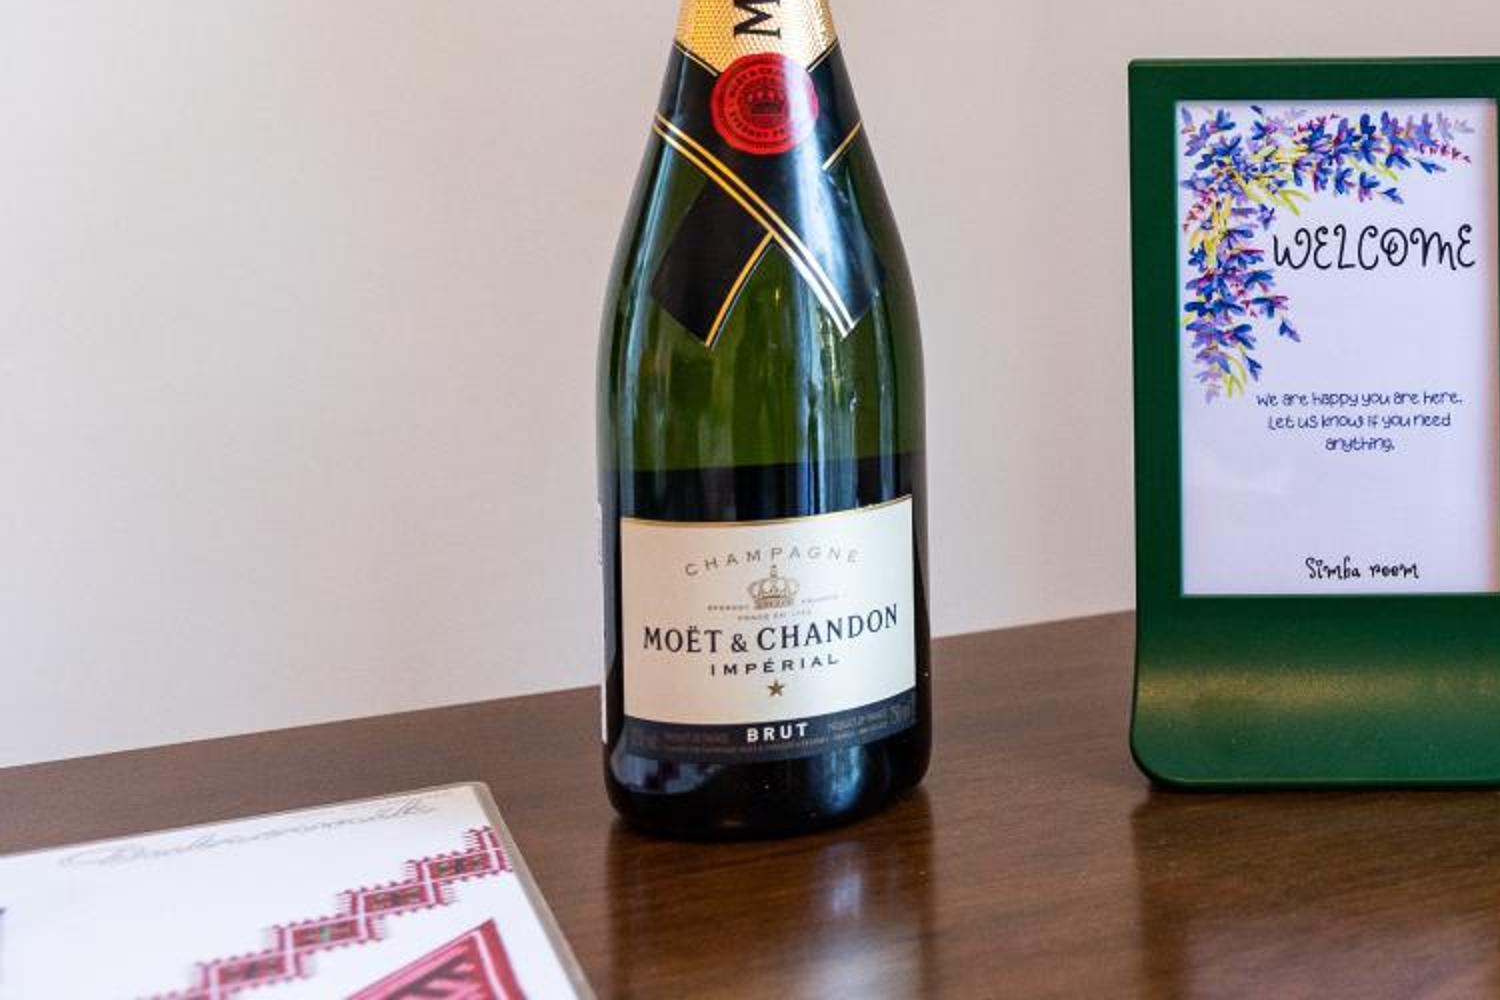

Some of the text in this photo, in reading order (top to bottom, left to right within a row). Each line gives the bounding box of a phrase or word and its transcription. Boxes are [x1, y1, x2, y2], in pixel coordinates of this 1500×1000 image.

[1272, 223, 1476, 271] WELCOME
[1282, 392, 1309, 406] are
[1312, 391, 1358, 407] happy
[1361, 391, 1390, 406] you
[1393, 391, 1418, 405] are
[1423, 390, 1463, 405] here.
[1267, 412, 1451, 430] Let us know if you need
[1325, 436, 1395, 452] anything.
[684, 546, 860, 577] CHAMPAGNE
[1305, 555, 1419, 580] Simba room
[643, 603, 899, 654] MOËT & CHANDON
[710, 654, 840, 676] IMPÉRIAL
[746, 722, 809, 743] BRUT
